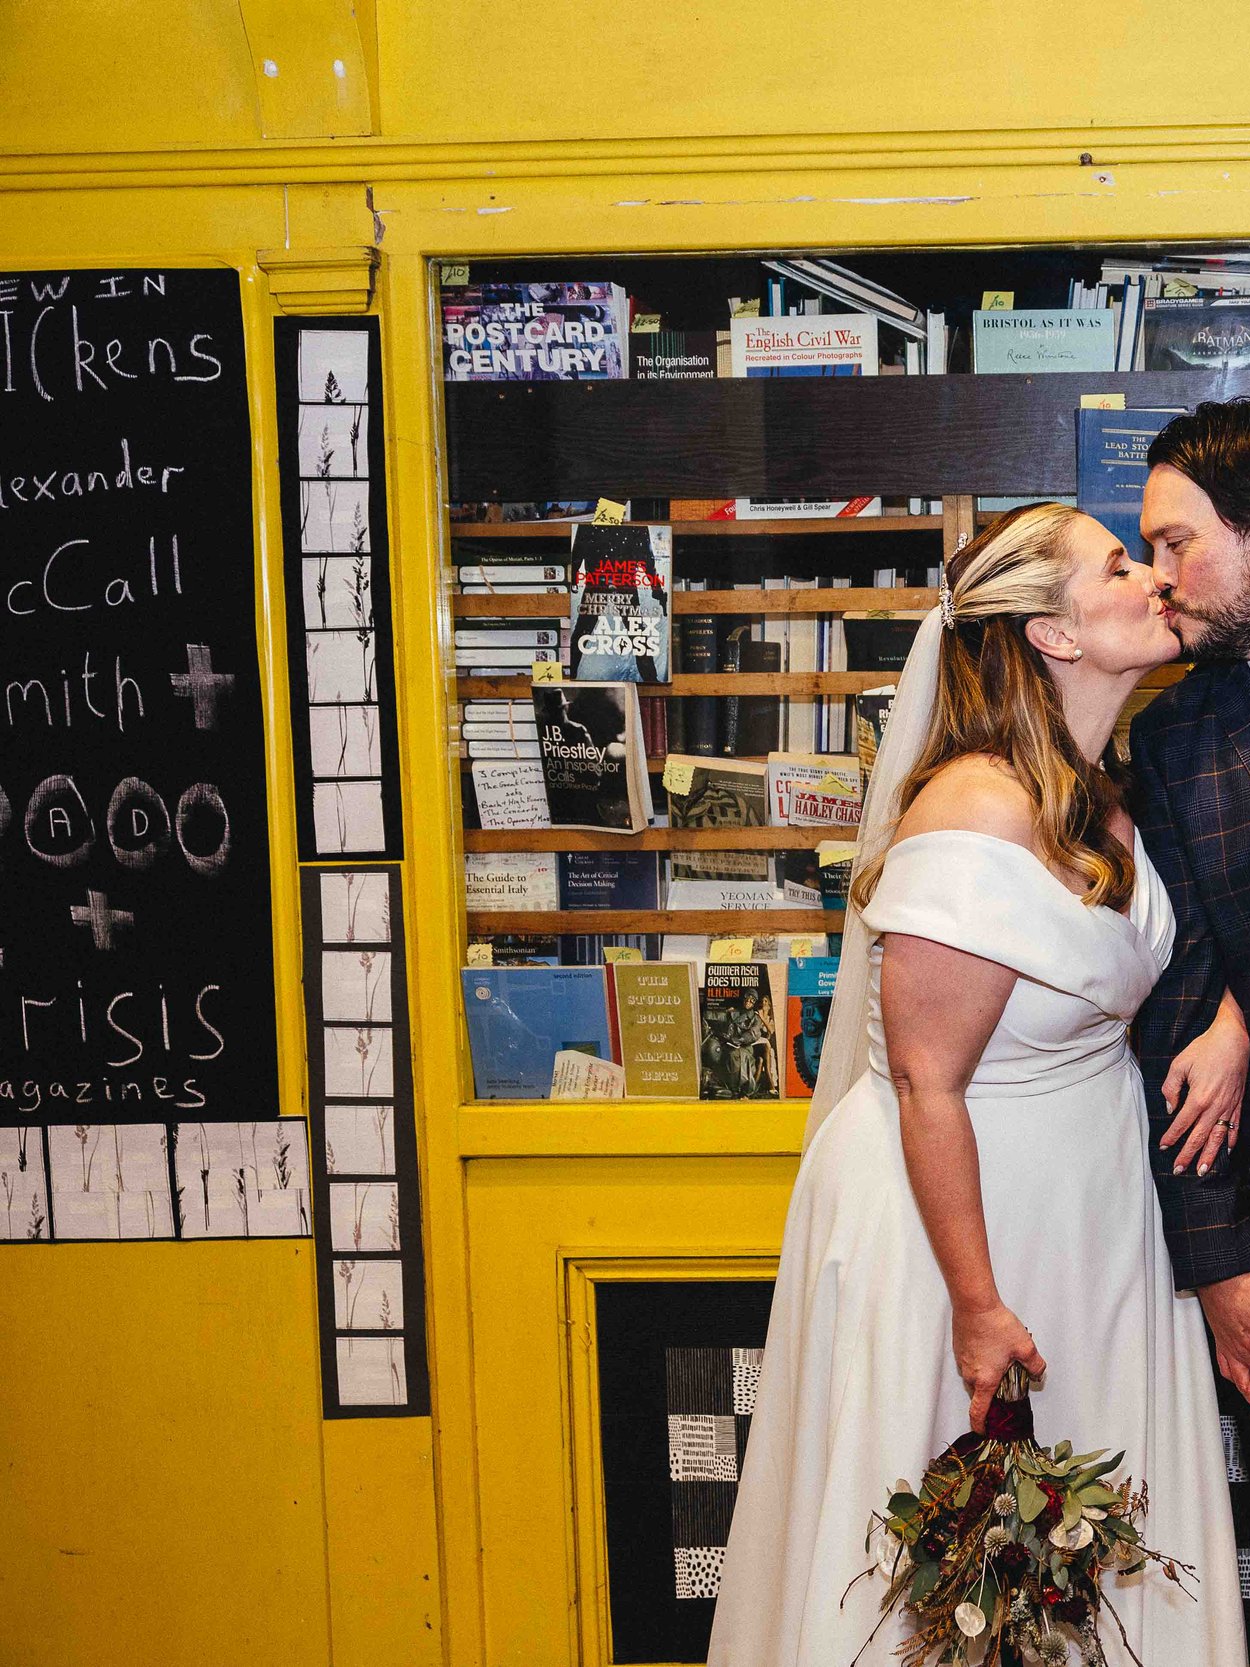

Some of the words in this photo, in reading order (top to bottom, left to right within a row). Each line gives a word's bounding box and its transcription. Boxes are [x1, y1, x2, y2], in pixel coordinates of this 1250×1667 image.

[95, 274, 166, 299] IN
[500, 302, 545, 317] THE
[983, 318, 1036, 328] BRISTOL
[1040, 318, 1054, 328] AS
[1060, 318, 1072, 328] IT
[1075, 318, 1101, 328] WAS
[447, 320, 605, 345] POSTCARD
[756, 327, 770, 337] The
[745, 331, 794, 352] English
[797, 330, 832, 347] Civil
[834, 329, 862, 346] War
[450, 348, 606, 373] CENTURY
[637, 355, 653, 367] The
[655, 355, 709, 368] Organisation
[745, 353, 782, 362] Recreated
[791, 353, 815, 361] Colour
[817, 351, 863, 361] Photographs
[1105, 442, 1128, 450] LEAD
[1132, 443, 1150, 451] STO
[766, 504, 796, 513] Honeywell
[814, 503, 831, 512] Spear
[595, 559, 647, 573] JAMES
[576, 571, 665, 587] PATTERSON
[585, 592, 634, 605] MERRY
[593, 615, 660, 636] ALEX
[577, 634, 660, 657] CROSS
[542, 725, 565, 742] J.B.
[543, 741, 607, 763] Priestley
[490, 765, 544, 778] Complete
[547, 759, 562, 769] An
[564, 758, 620, 773] Inspector
[547, 770, 575, 783] Calls
[796, 792, 862, 809] JAMES
[795, 800, 835, 819] HADLEY
[835, 806, 862, 824] CHAS
[466, 873, 484, 882] The
[486, 872, 515, 882] Guide
[517, 874, 527, 882] to
[597, 871, 619, 879] Critical
[466, 884, 505, 894] Essential
[508, 884, 528, 896] Italy
[568, 880, 592, 888] Decision
[593, 880, 616, 889] Making
[720, 891, 774, 901] YEOMAN
[801, 889, 816, 901] THIS
[493, 946, 536, 954] Smithsonian
[708, 965, 740, 976] GUNNER
[637, 976, 669, 986] THE
[707, 976, 729, 987] GOES
[729, 976, 741, 987] TO
[627, 995, 681, 1005] STUDIO
[636, 1014, 676, 1024] BOOK
[648, 1033, 667, 1043] OF
[634, 1052, 684, 1062] ALPHA
[641, 1071, 679, 1081] BETS
